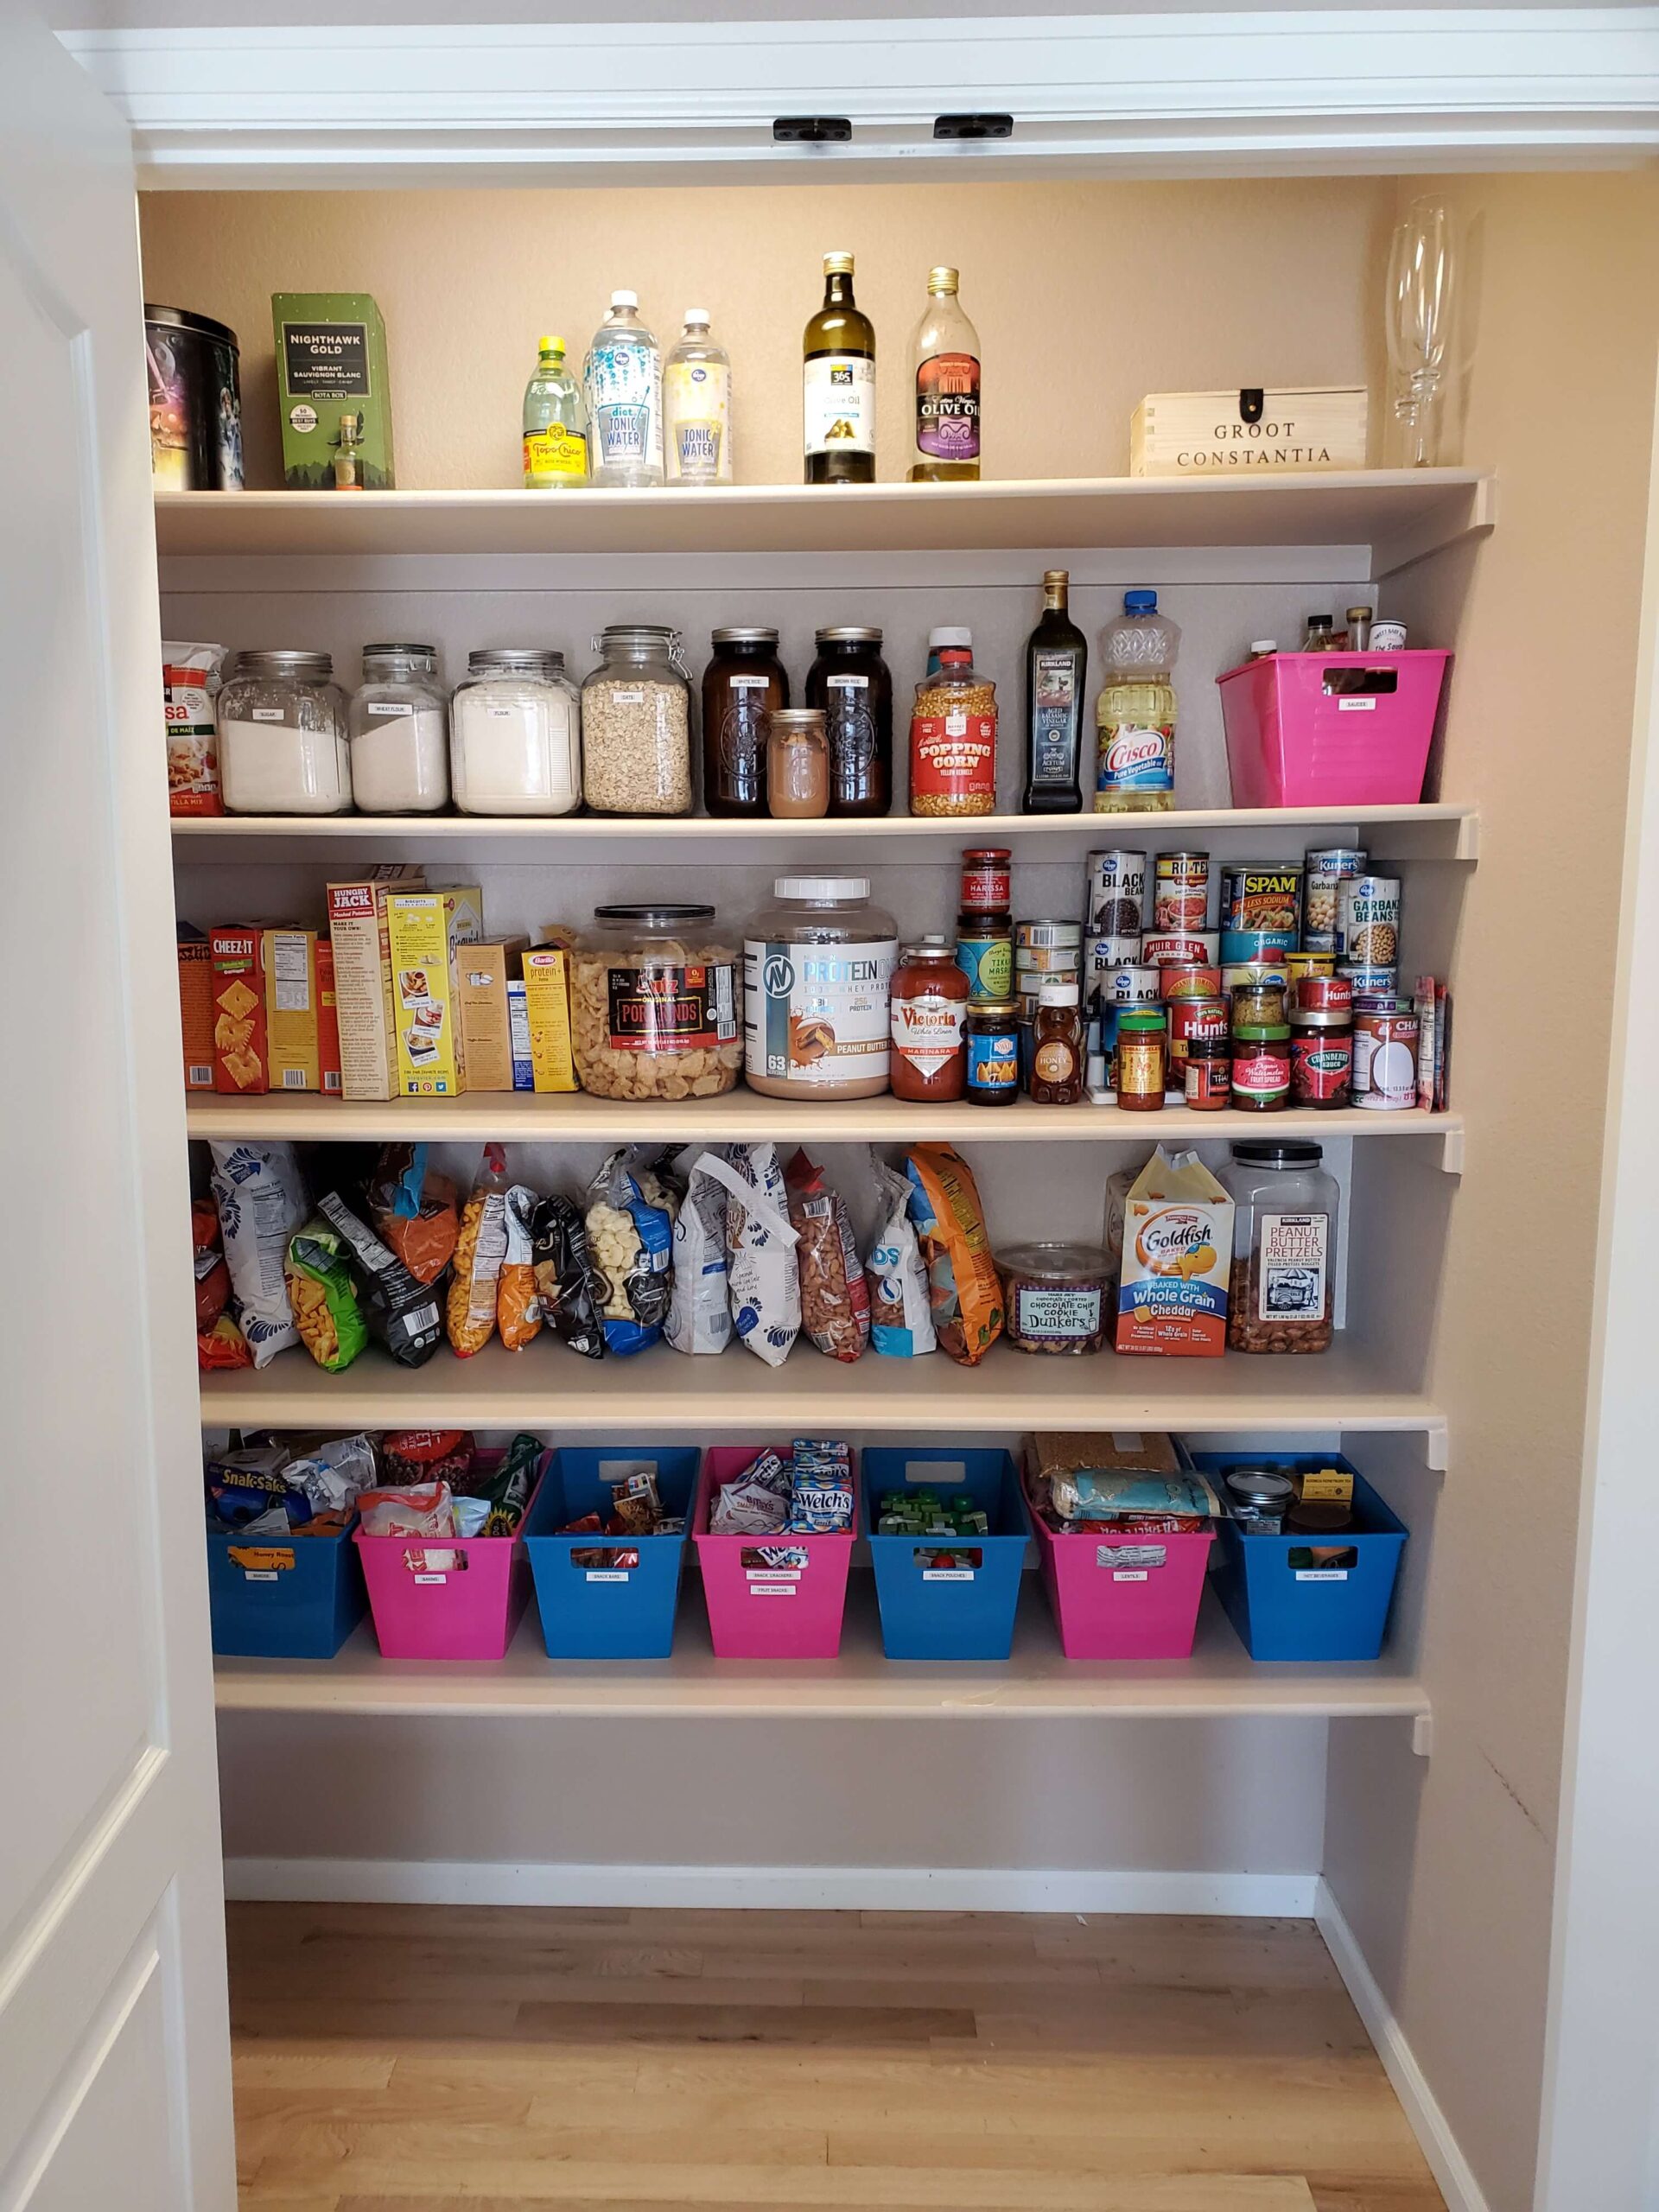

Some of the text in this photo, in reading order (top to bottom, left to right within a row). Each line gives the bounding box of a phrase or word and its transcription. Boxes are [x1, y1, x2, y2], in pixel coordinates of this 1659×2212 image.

[290, 334, 360, 345] NIGHTHAWK
[310, 345, 342, 354] GOLD
[833, 372, 851, 382] 365
[613, 407, 632, 416] diet
[921, 403, 961, 415] OLIVE
[609, 417, 636, 431] TONIC
[684, 429, 711, 442] TONIC
[1214, 423, 1295, 439] GROOT
[607, 432, 639, 446] WATER
[682, 443, 714, 456] WATER
[1177, 448, 1332, 467] CONSTANTIA
[919, 743, 991, 759] POPPING
[1109, 742, 1159, 771] Crisco
[932, 755, 980, 768] CORN
[1114, 759, 1156, 779] Pure Vegetable
[1319, 859, 1359, 872] Kuner's
[1103, 873, 1145, 888] BLACK
[1245, 877, 1297, 893] SPAM
[334, 887, 368, 897] HUNGRY
[334, 895, 371, 908] JACK
[1246, 898, 1262, 909] LESS
[1262, 895, 1289, 906] SODIUM
[1356, 912, 1393, 923] BEANS
[1148, 942, 1200, 953] MUIR GLEN
[1254, 937, 1288, 946] ORGANIC
[1353, 976, 1392, 988] Kuner's
[901, 1006, 956, 1030] Victoria
[934, 1027, 952, 1035] Linen
[836, 1041, 888, 1054] PEANUT BUTTER
[767, 1055, 785, 1070] 63
[1147, 1224, 1211, 1252] Goldfish
[1270, 1226, 1321, 1237] PEANUT
[1270, 1236, 1319, 1247] BUTTER
[1265, 1247, 1323, 1257] PRETZELS
[1179, 1282, 1199, 1292] WITH
[1030, 1300, 1076, 1309] CHOCOLATE
[1133, 1289, 1216, 1309] Whole Grain
[1044, 1309, 1079, 1318] COOKIE
[1150, 1305, 1197, 1318] Cheddar
[1027, 1314, 1086, 1328] Dunkers
[799, 1492, 850, 1510] Welch's
